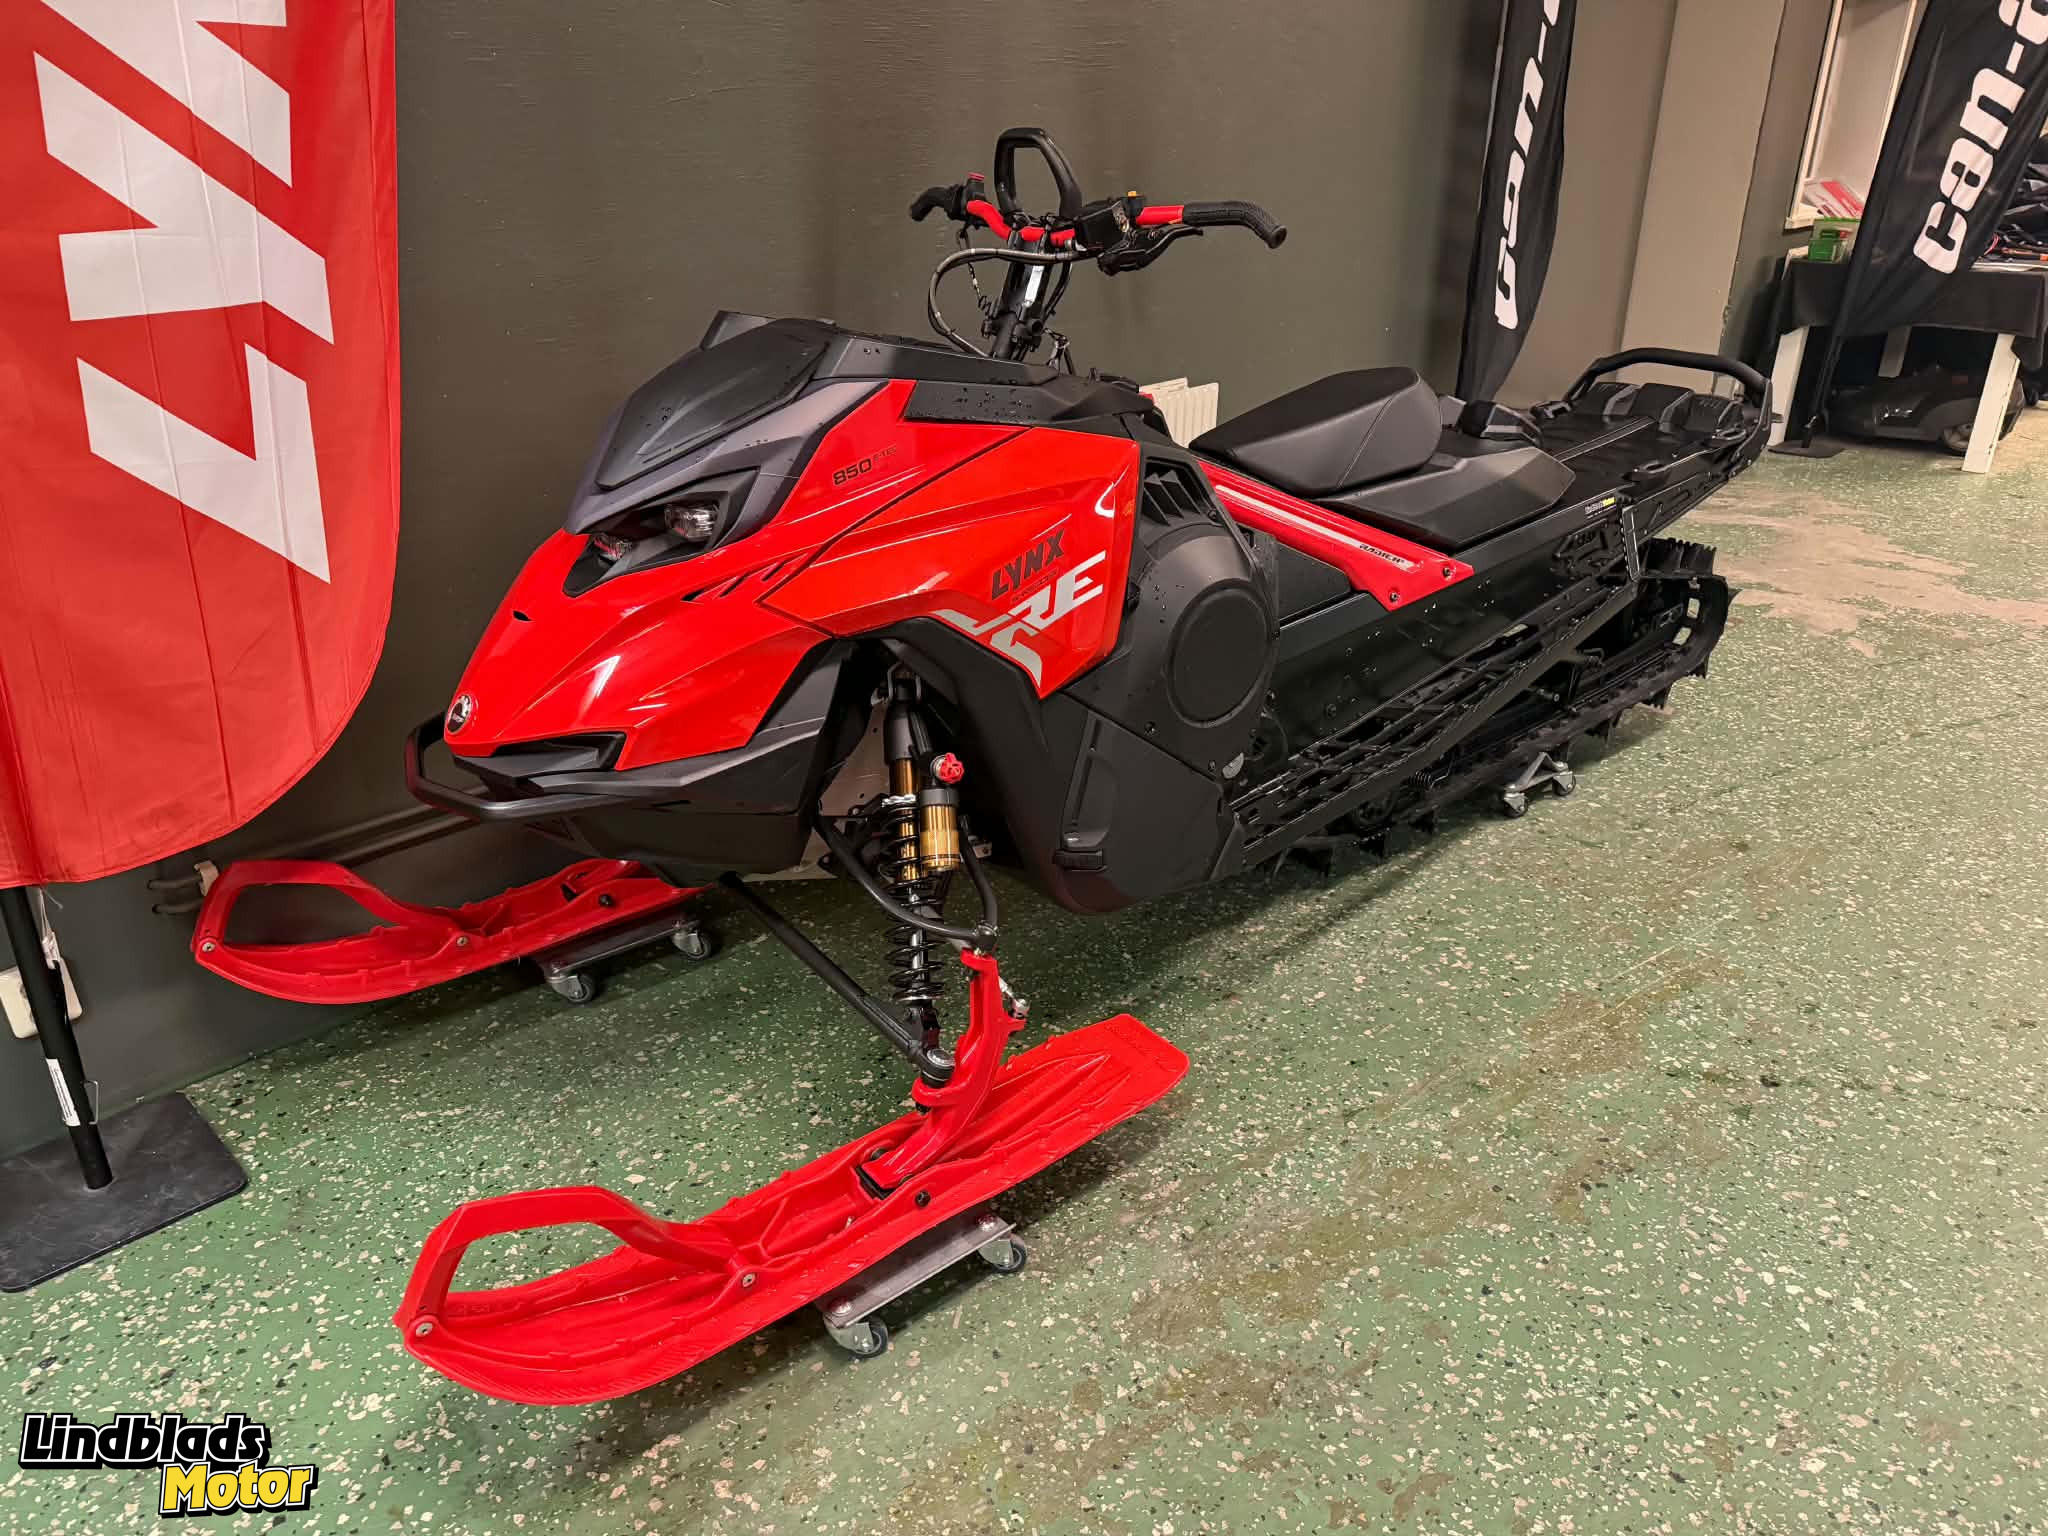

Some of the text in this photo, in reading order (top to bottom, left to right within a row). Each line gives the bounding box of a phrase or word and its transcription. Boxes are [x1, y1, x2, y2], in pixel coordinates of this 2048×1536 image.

[1494, 0, 1560, 330] can-
[833, 458, 872, 485] 850
[991, 528, 1065, 601] LYNX
